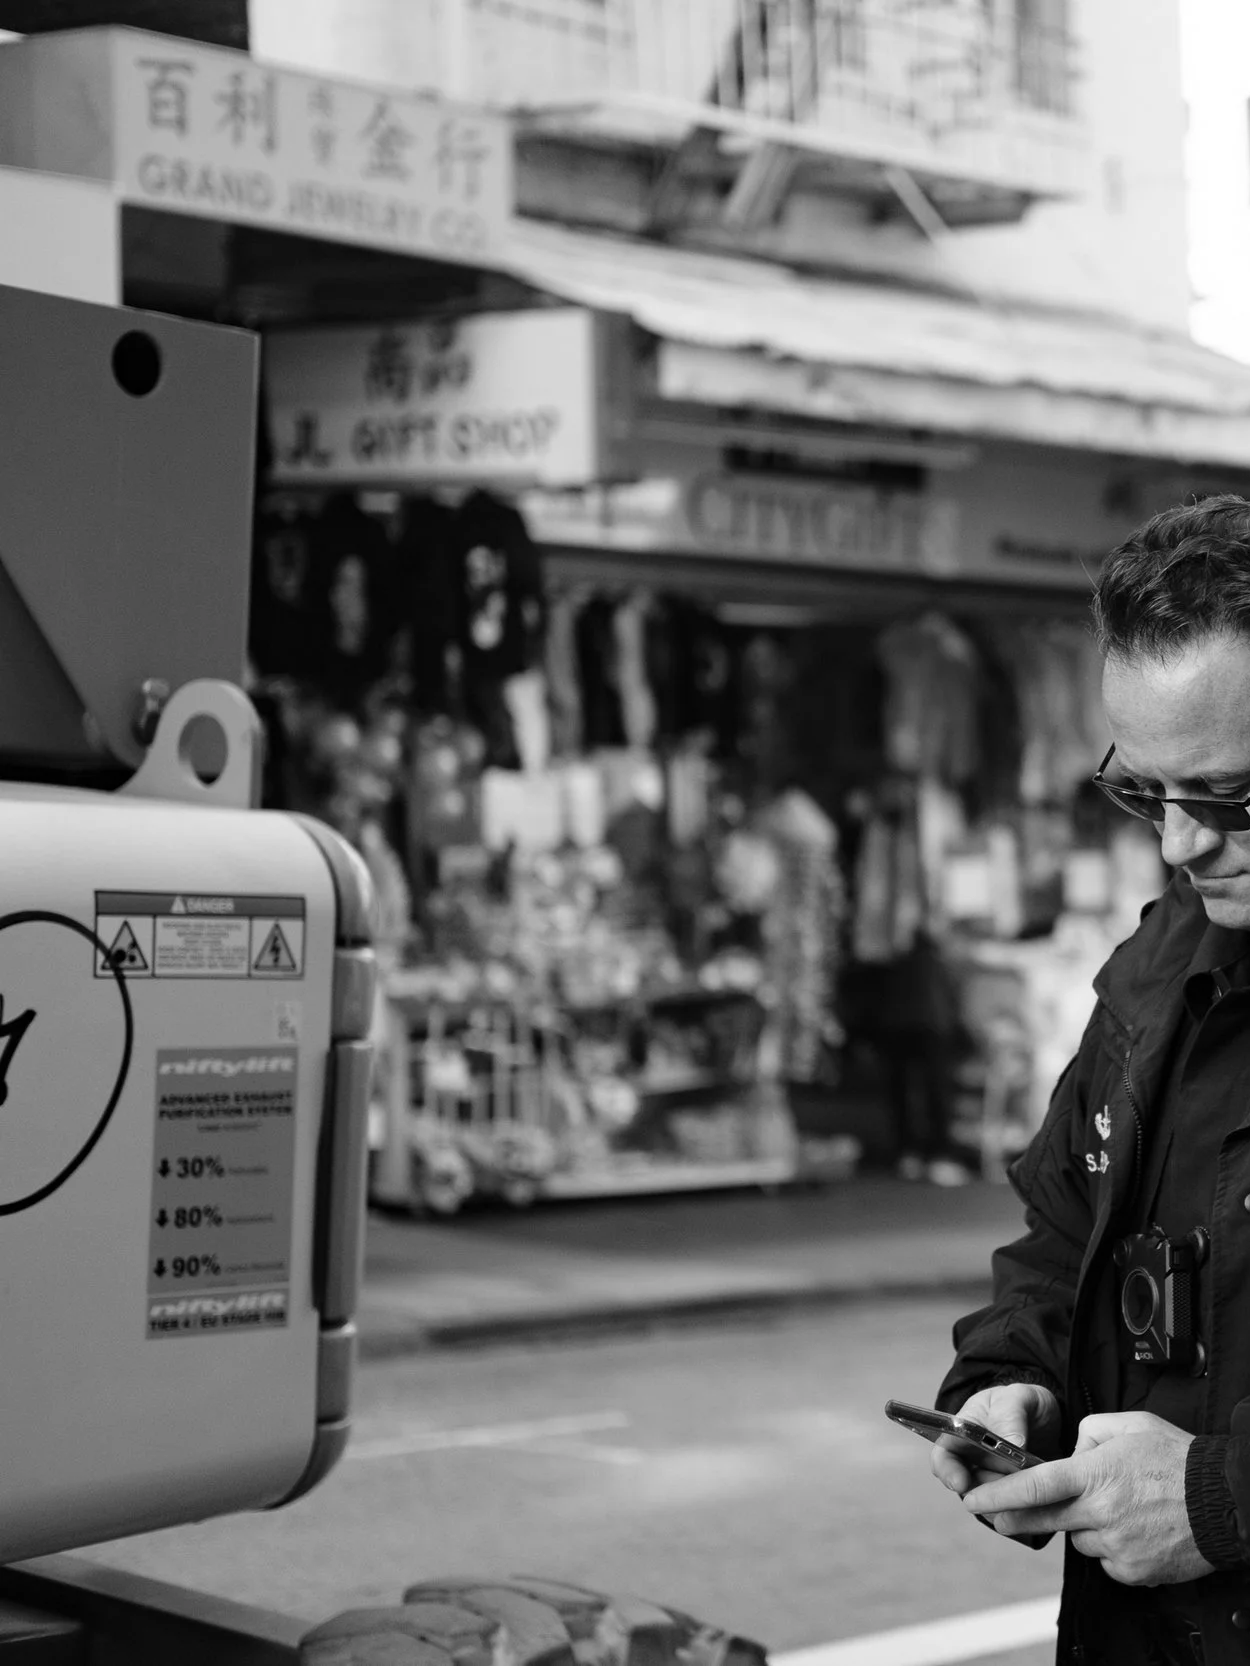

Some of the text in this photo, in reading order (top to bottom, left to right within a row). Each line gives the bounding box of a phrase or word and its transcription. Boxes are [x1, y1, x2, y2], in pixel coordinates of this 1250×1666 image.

[137, 152, 277, 211] GRAND
[352, 413, 438, 465] GIFT
[448, 404, 561, 462] SHOP
[187, 898, 236, 914] DANGER
[160, 1092, 230, 1106] ADVANCED
[175, 1155, 226, 1179] 30%
[173, 1204, 223, 1229] 80%
[171, 1253, 222, 1279] 90%
[150, 1318, 179, 1331] TIER
